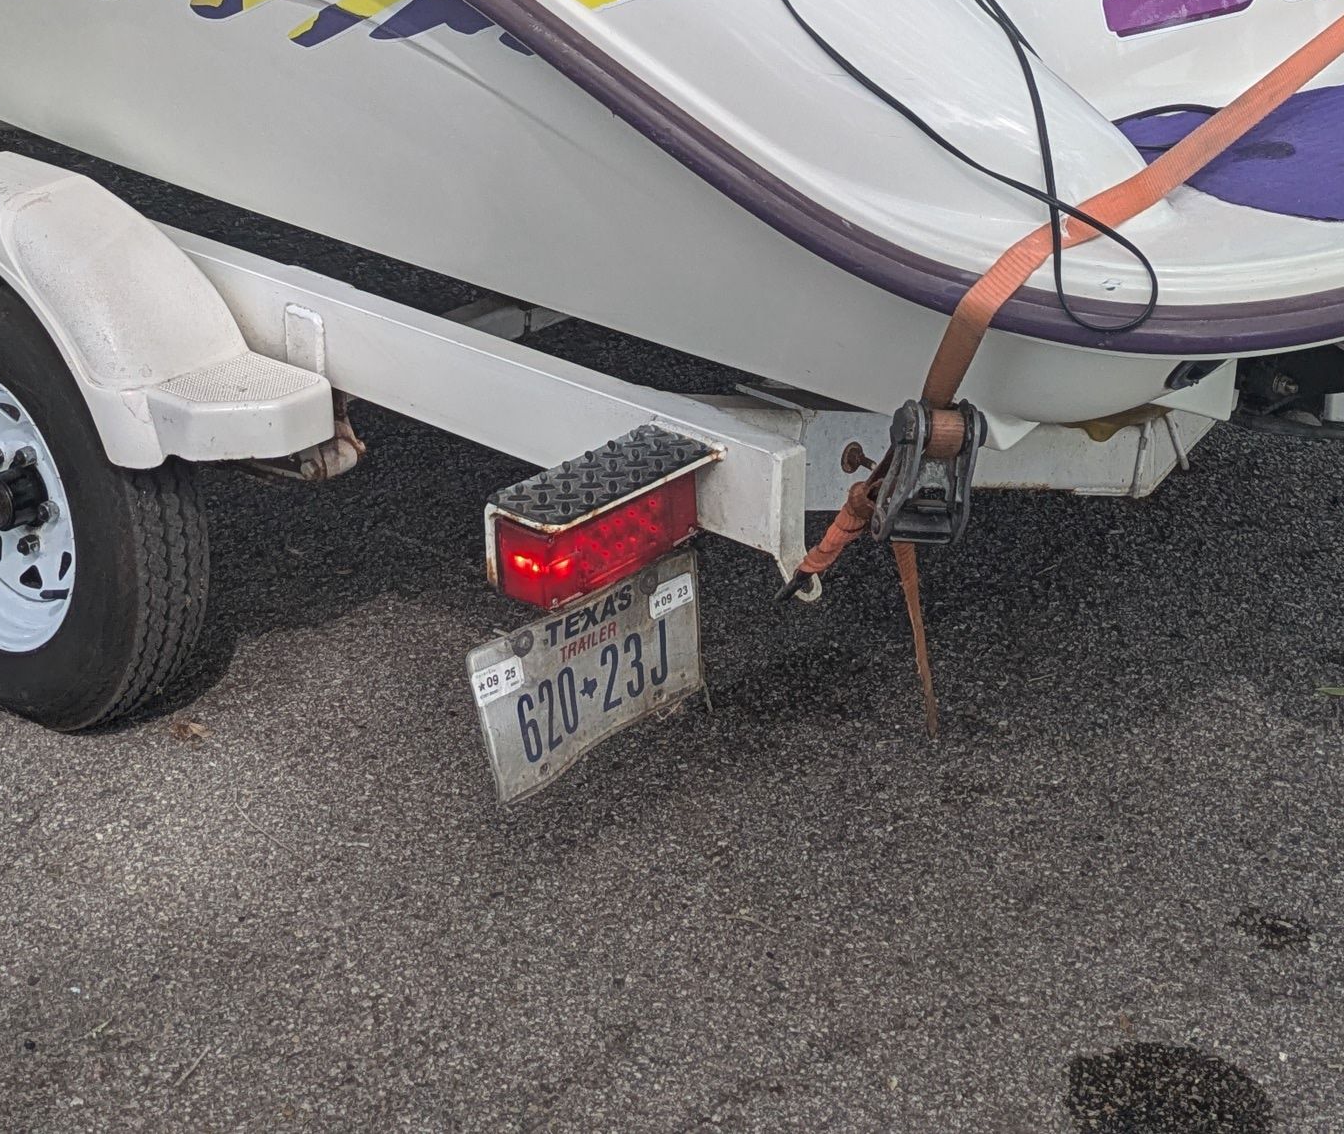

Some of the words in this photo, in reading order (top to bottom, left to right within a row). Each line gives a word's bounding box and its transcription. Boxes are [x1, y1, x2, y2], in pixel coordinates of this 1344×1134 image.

[545, 584, 633, 648] TEXAS
[661, 593, 673, 607] 09
[677, 585, 689, 599] 23
[559, 621, 617, 663] TRAILER
[486, 674, 499, 689] 09
[504, 667, 517, 682] 25
[517, 666, 580, 764] 620
[600, 618, 669, 712] 23J
